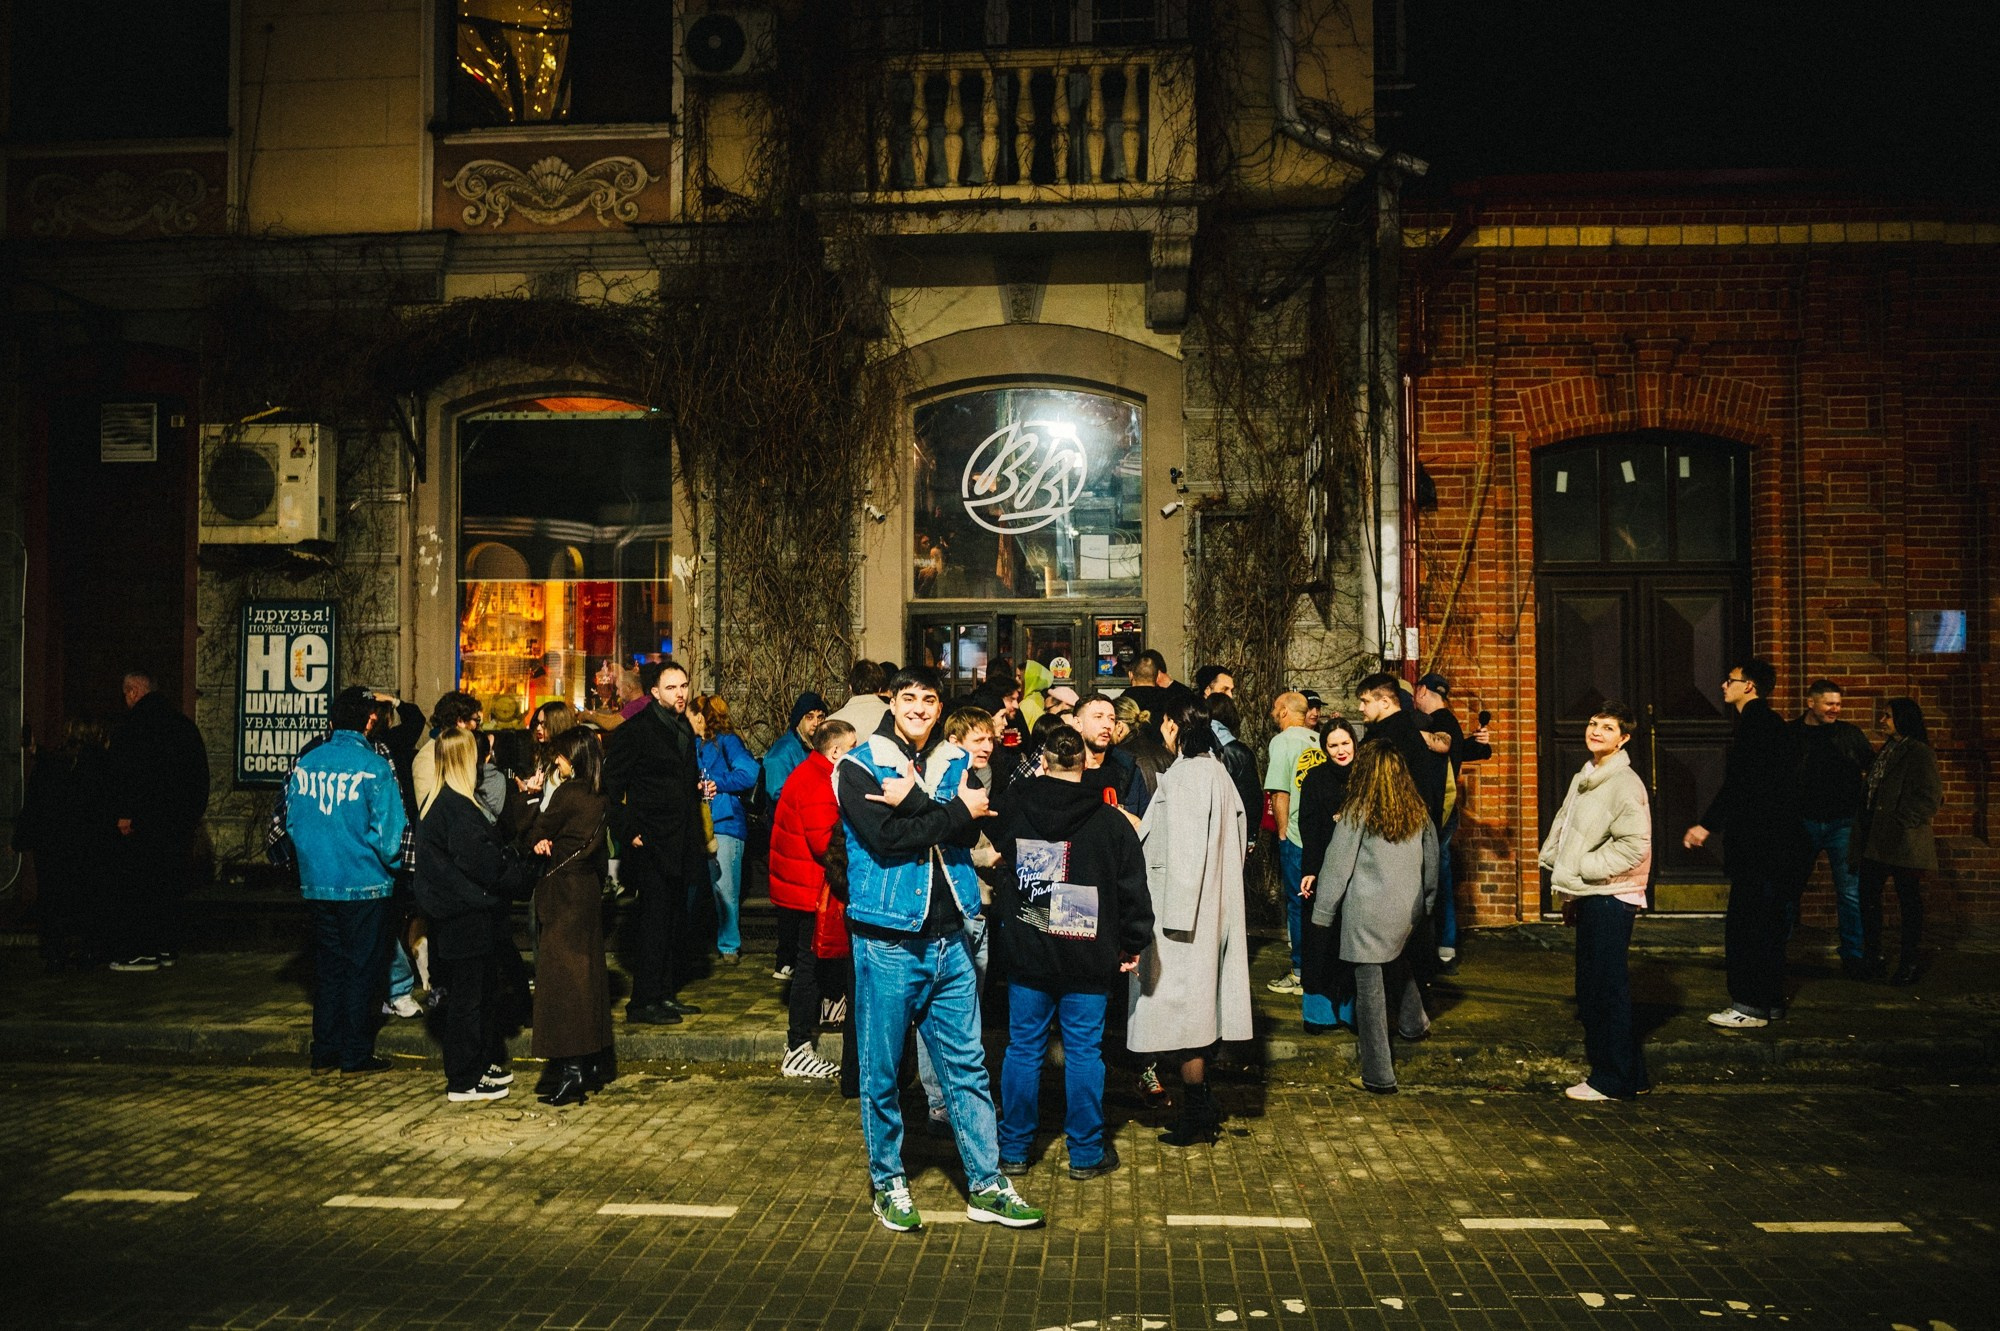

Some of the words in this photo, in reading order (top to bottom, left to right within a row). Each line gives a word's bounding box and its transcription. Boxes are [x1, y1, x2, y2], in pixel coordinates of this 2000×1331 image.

[249, 622, 329, 636] пожалуйста
[245, 692, 328, 715] ШУМИТЕ
[245, 715, 328, 729] УВАЖАЙТЕ
[244, 730, 325, 754] НАШИ
[1047, 929, 1098, 941] MONACO
